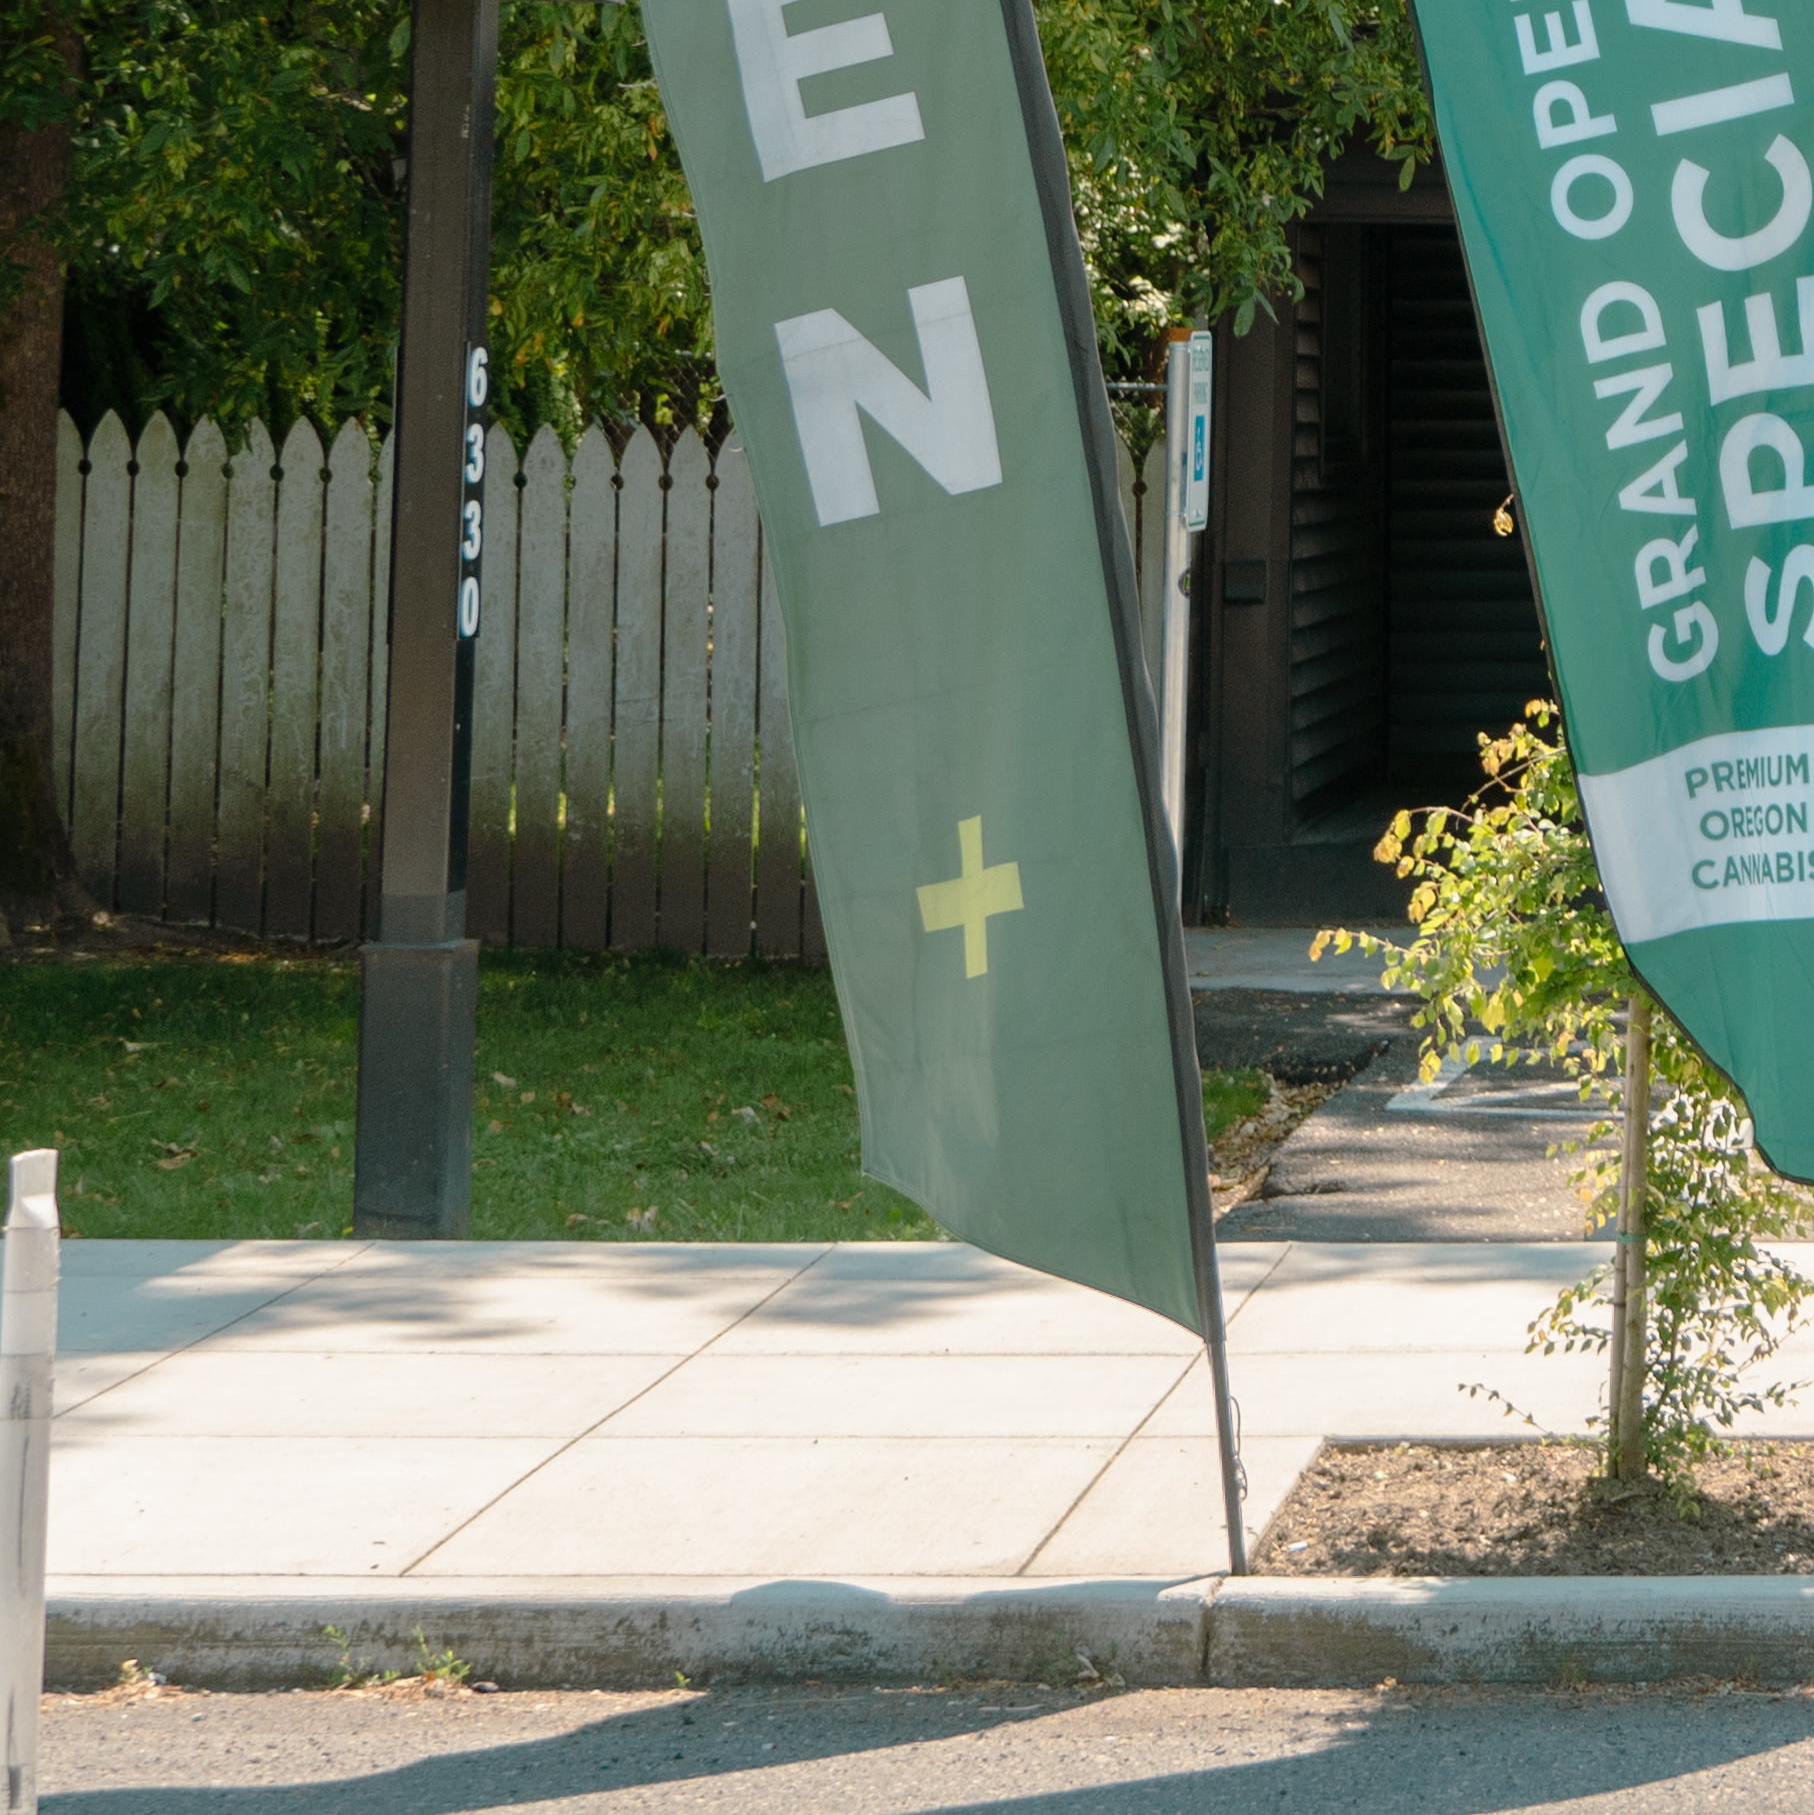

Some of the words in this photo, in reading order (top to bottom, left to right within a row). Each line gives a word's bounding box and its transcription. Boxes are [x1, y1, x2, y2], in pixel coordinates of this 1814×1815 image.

[459, 346, 489, 639] 6330
[1579, 280, 1719, 683] GRAND
[1684, 753, 1810, 799] PREMIUM
[1700, 802, 1808, 841] OREGON
